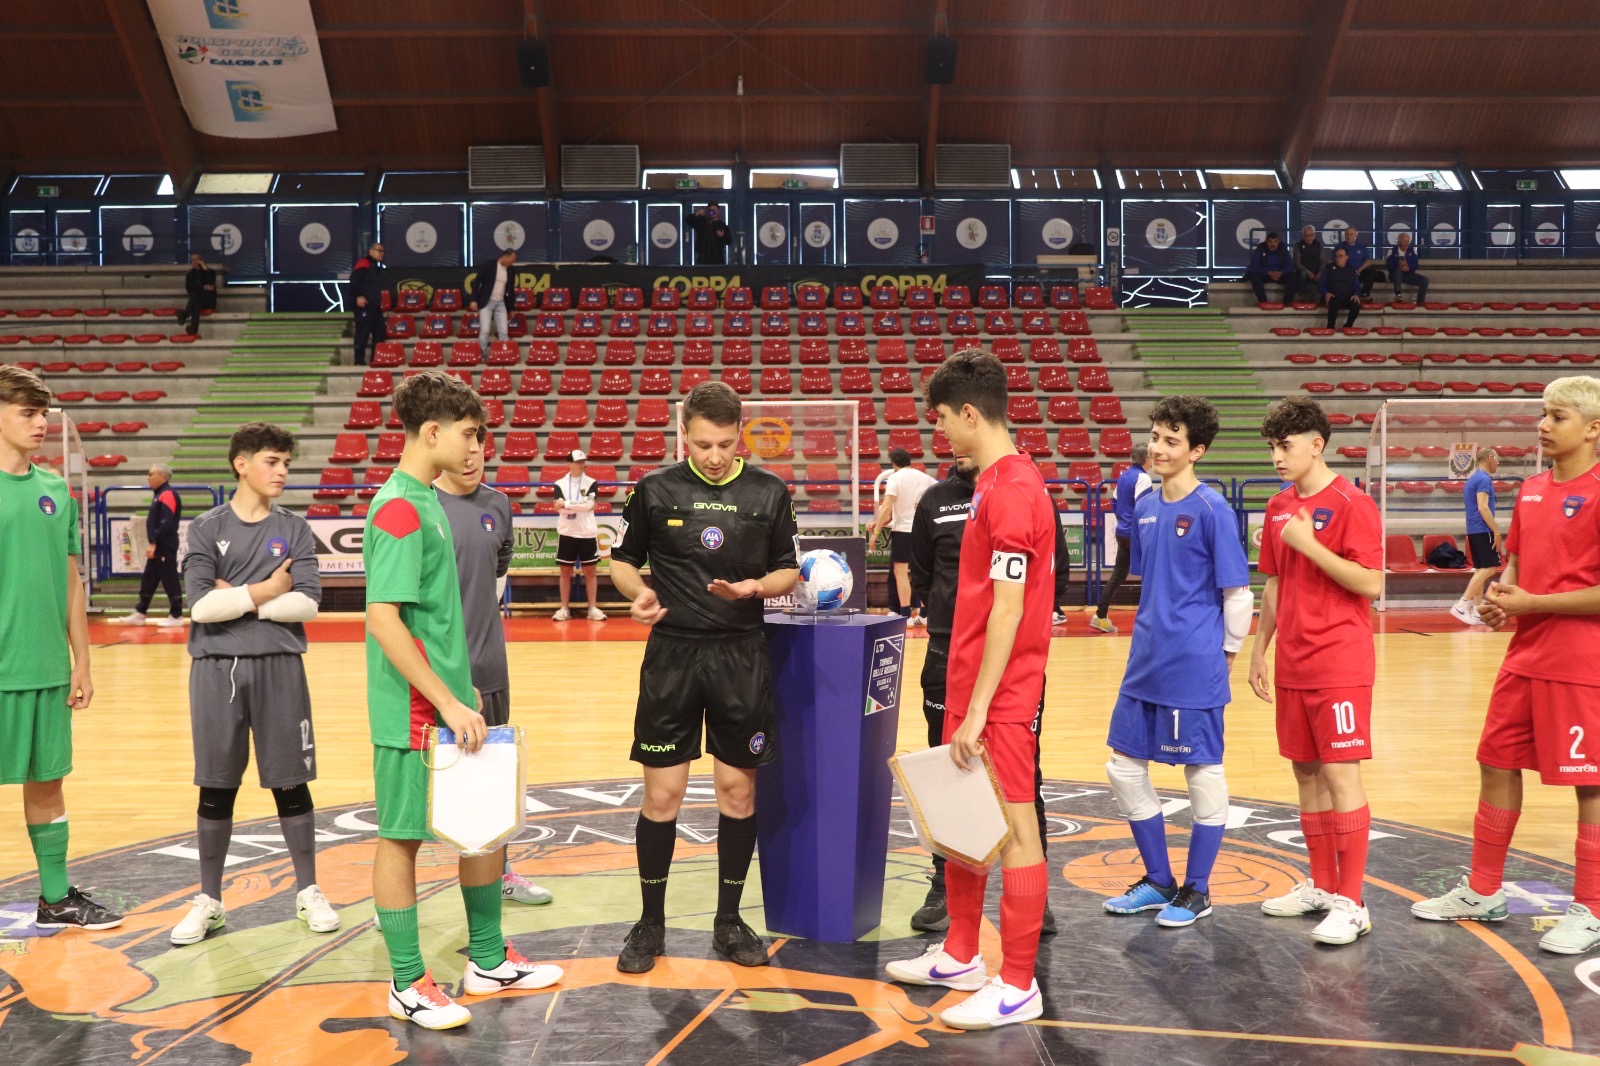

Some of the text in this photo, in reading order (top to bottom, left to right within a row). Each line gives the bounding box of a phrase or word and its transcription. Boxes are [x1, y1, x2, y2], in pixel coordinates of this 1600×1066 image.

[694, 503, 737, 512] GIVOVA
[706, 532, 719, 541] AIA
[1006, 557, 1023, 580] C
[1172, 709, 1179, 740] 1
[1332, 701, 1356, 734] 10
[300, 719, 314, 751] 12
[1331, 738, 1365, 749] macron
[1569, 725, 1586, 759] 2
[1160, 744, 1192, 753] macron
[1559, 763, 1598, 773] macron
